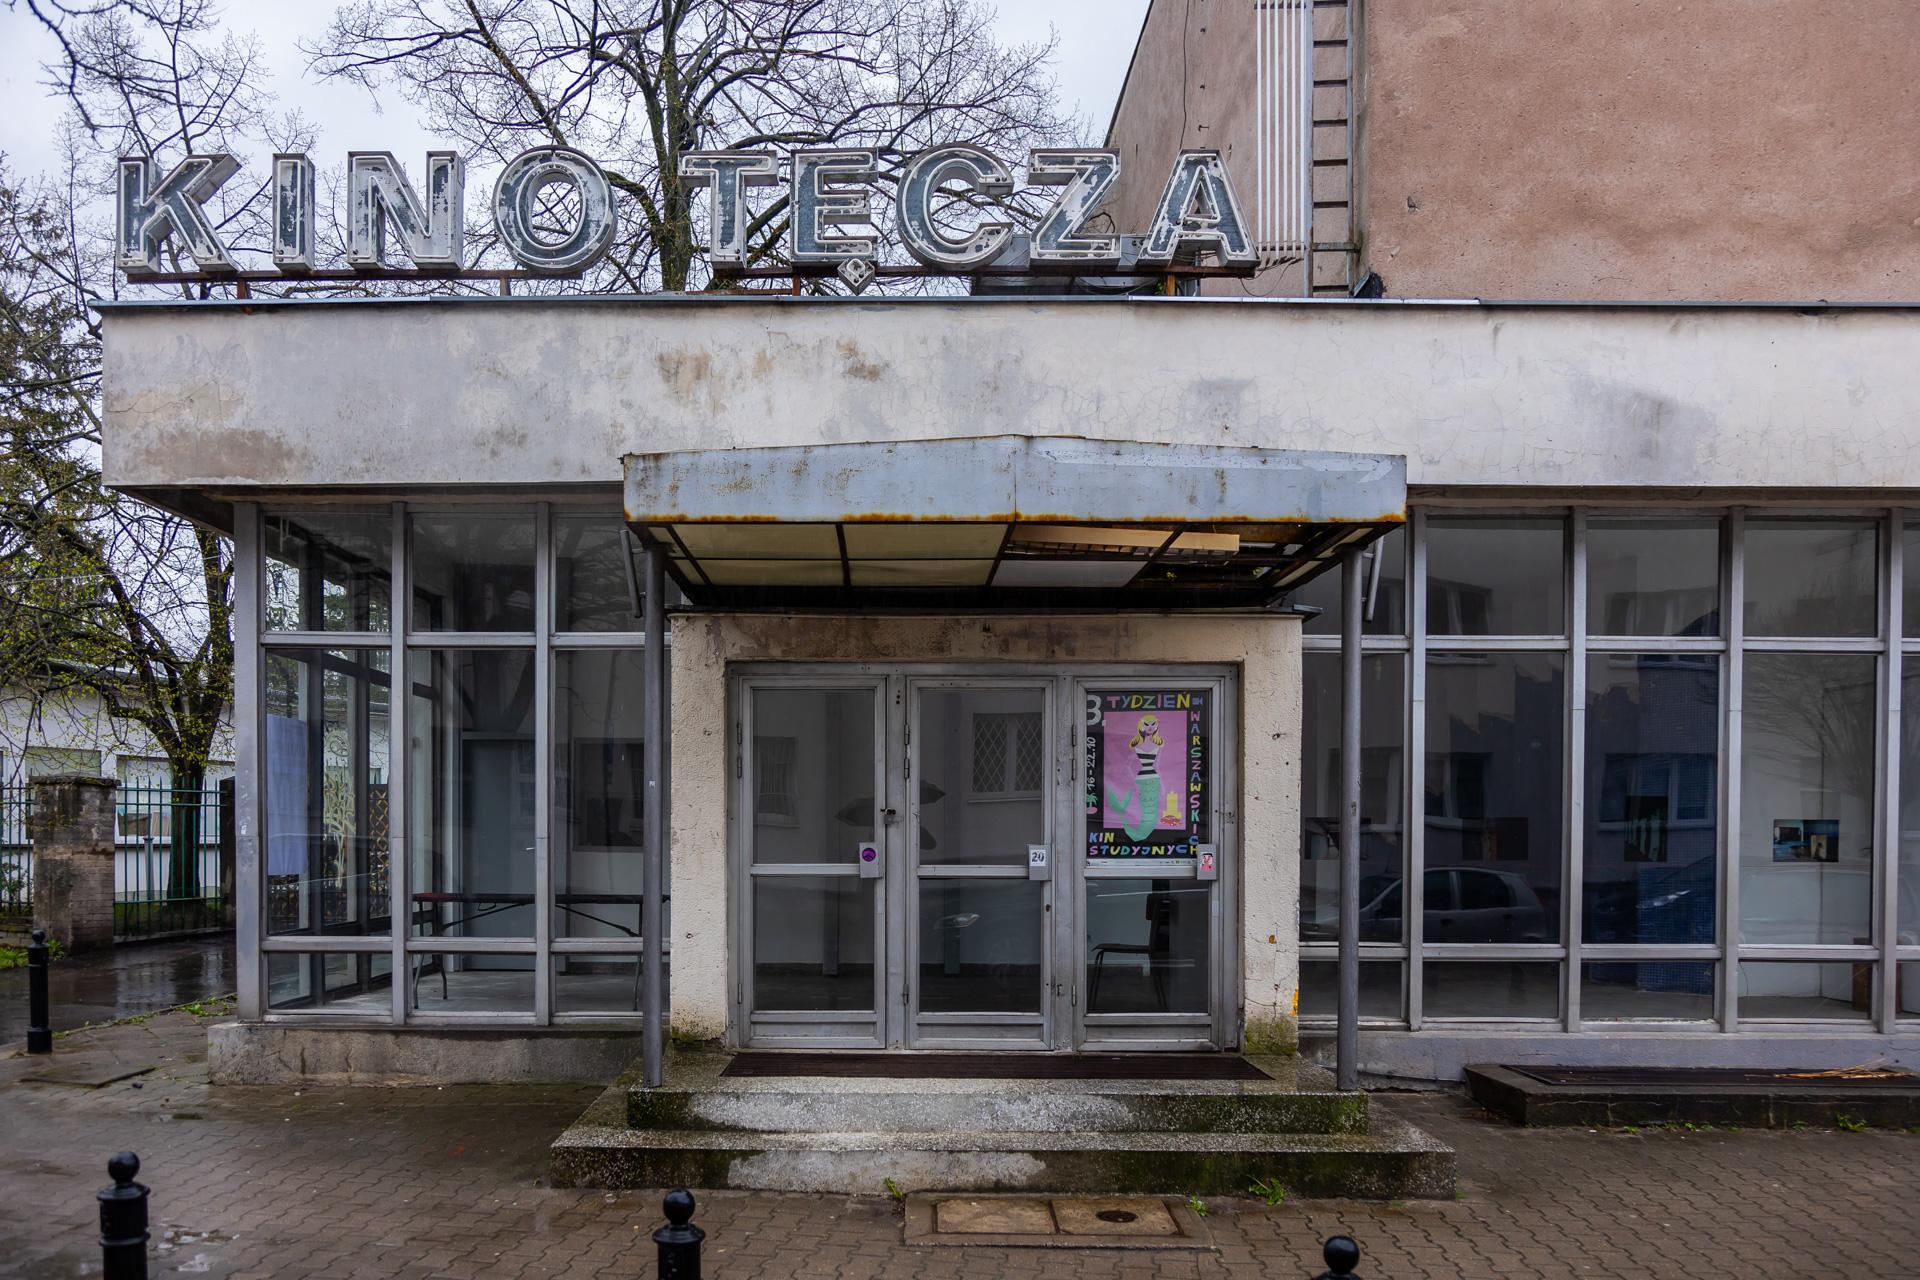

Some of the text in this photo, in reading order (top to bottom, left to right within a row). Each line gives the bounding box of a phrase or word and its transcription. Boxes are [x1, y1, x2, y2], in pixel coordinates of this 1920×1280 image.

[117, 146, 618, 274] KINO
[1106, 690, 1191, 709] TYDZIEŃ
[1089, 832, 1115, 843] KIN
[1089, 844, 1198, 856] STUDYJNYCH
[1031, 851, 1045, 862] 20
